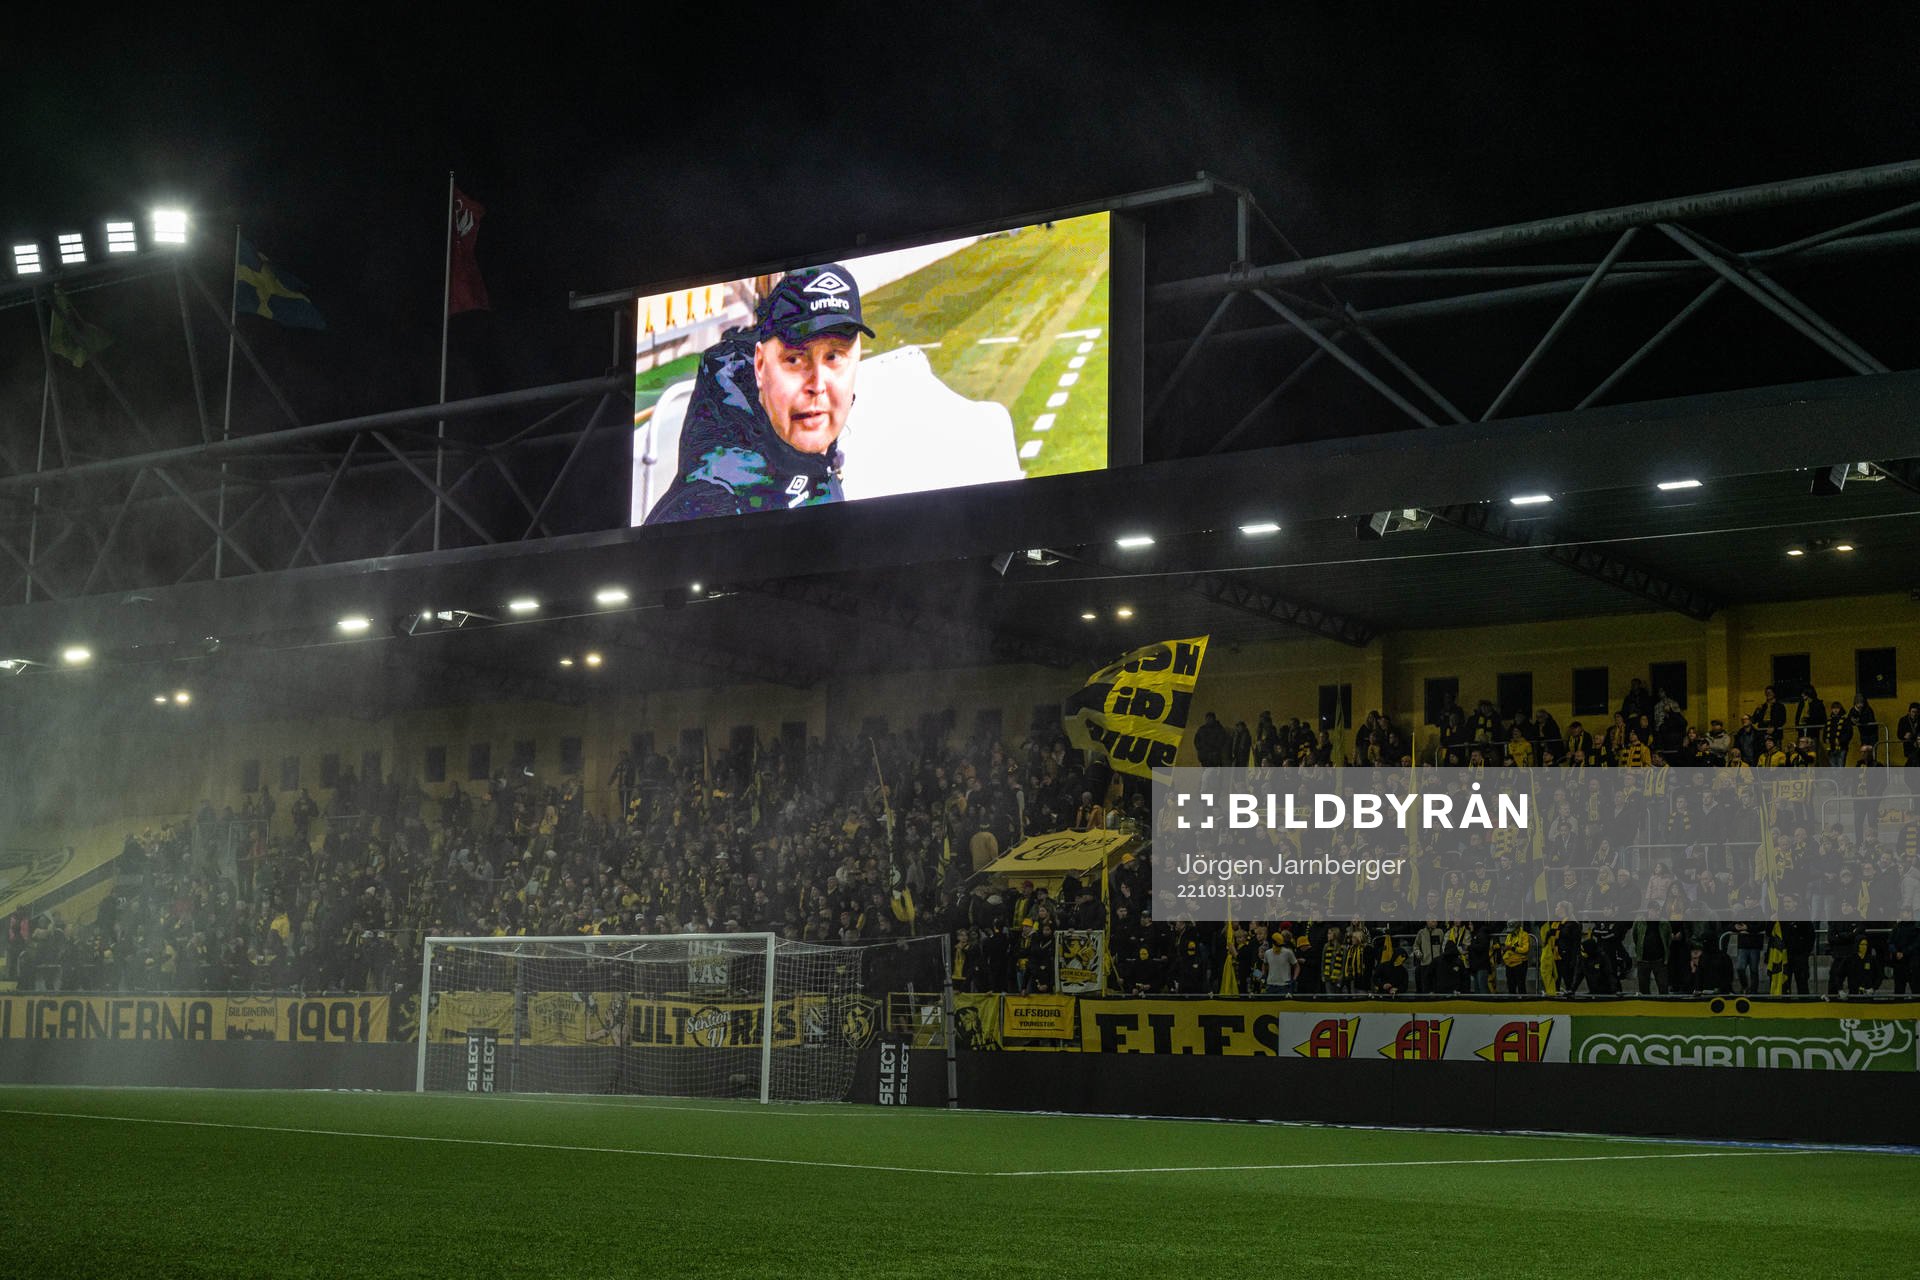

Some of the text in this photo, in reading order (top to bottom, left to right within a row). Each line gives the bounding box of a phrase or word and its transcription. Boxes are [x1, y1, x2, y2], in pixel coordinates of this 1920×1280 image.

[810, 294, 850, 311] umbro
[287, 1001, 371, 1042] 1991
[467, 1035, 480, 1092] SELECT
[482, 1035, 497, 1093] SELECT
[878, 1042, 897, 1105] SELECT
[898, 1042, 911, 1105] SELECT
